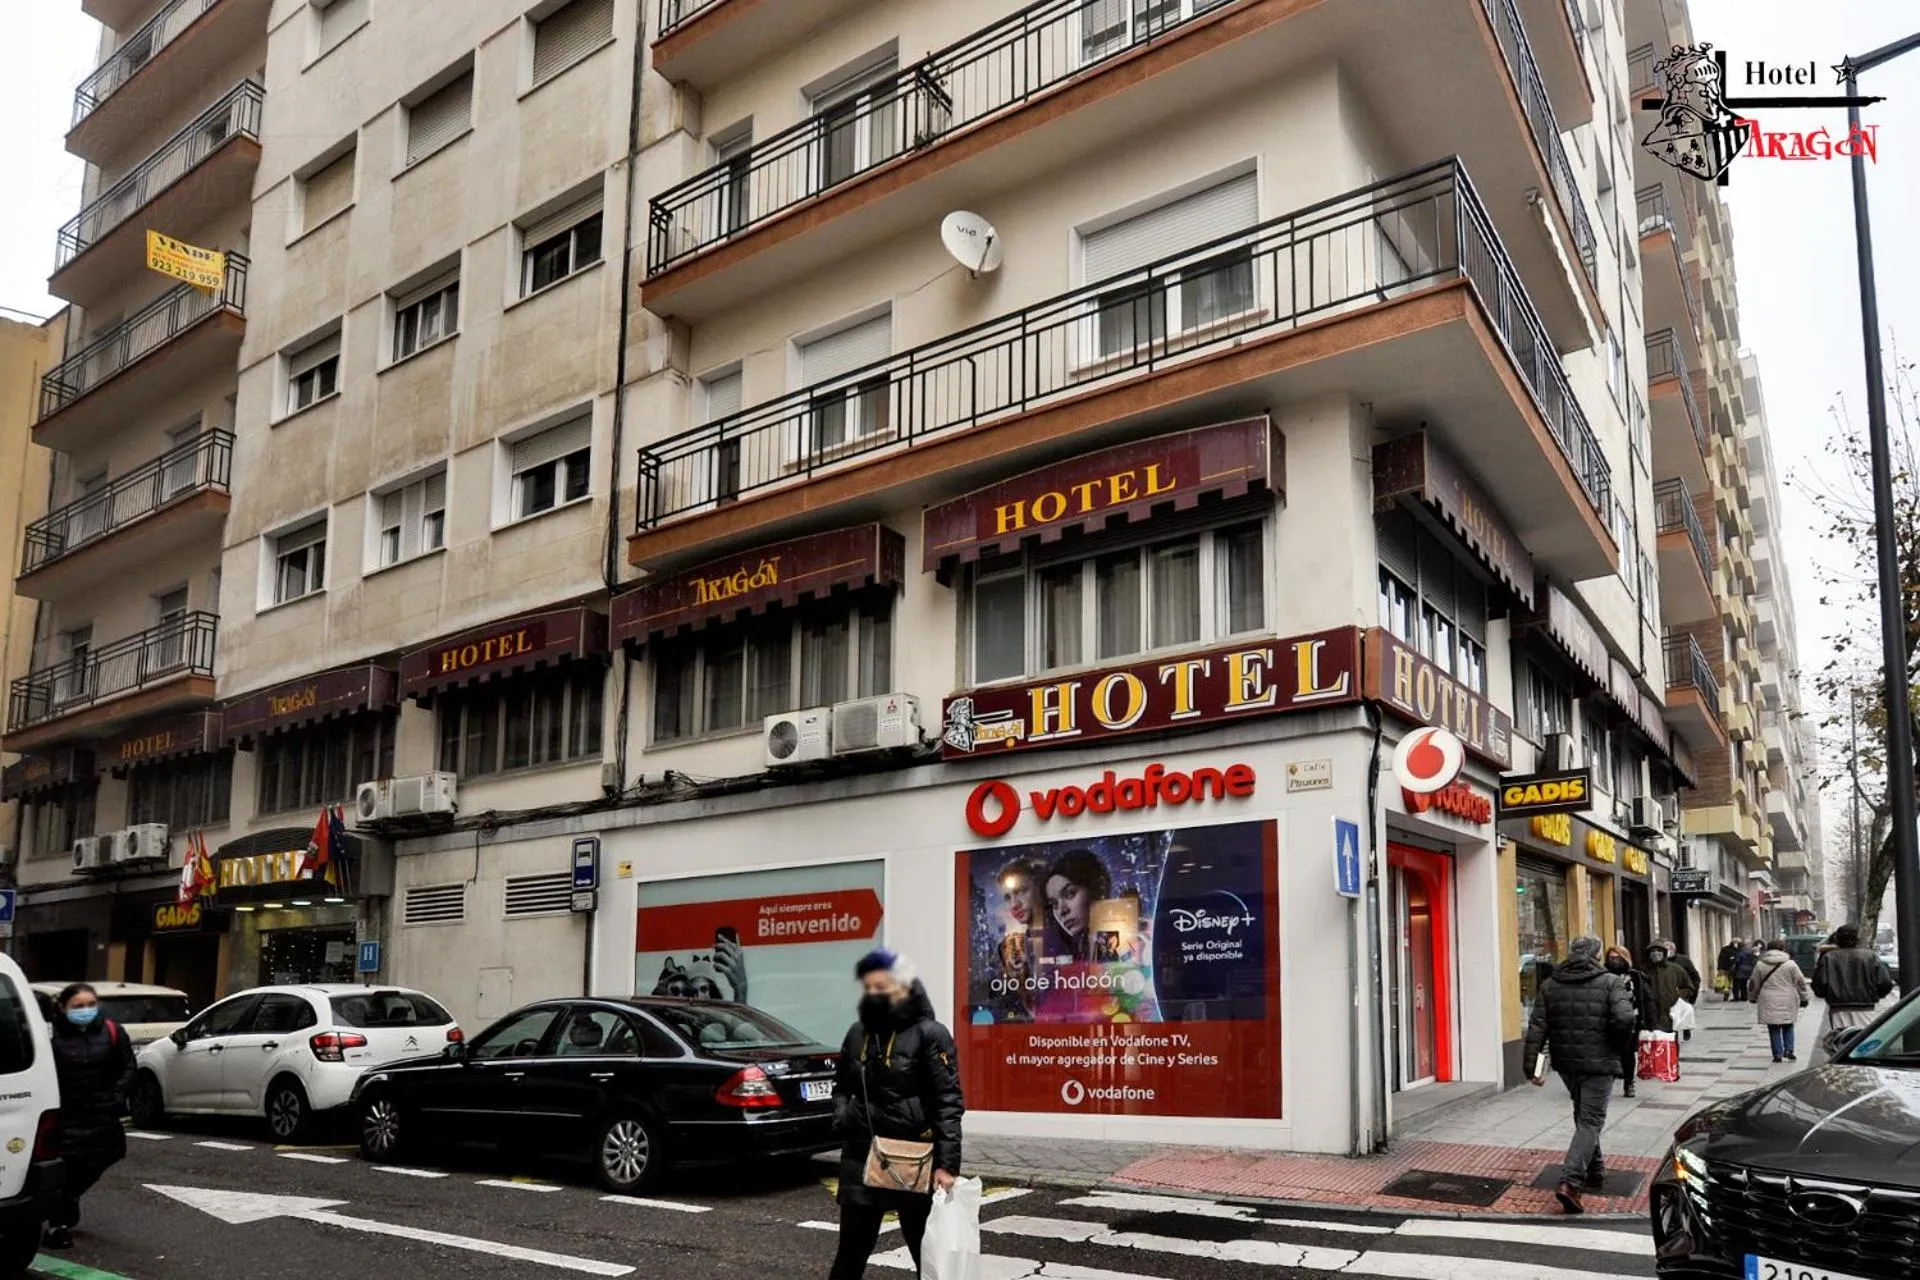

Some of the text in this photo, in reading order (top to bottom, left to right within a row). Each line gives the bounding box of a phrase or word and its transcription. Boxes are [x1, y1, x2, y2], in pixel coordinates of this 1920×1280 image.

[151, 257, 172, 273] 923
[175, 265, 196, 280] 219
[994, 462, 1177, 534] HOTEL
[441, 629, 533, 673] HOTEL
[1026, 639, 1350, 743] HOTEL
[1392, 645, 1485, 751] HOTEL
[121, 731, 175, 760] HOTEL
[1029, 763, 1256, 821] vodafone
[1504, 779, 1585, 806] GADIS
[155, 902, 200, 929] GADIS
[779, 902, 812, 914] siempre
[813, 901, 832, 911] eres
[757, 912, 862, 937] Bienvenido
[1181, 940, 1243, 952] Serie Original
[1183, 950, 1244, 964] ya disponible
[990, 969, 1126, 996] ojo de halcón
[1028, 1034, 1191, 1049] Disponible en Vodafone TV,
[1005, 1053, 1219, 1068] el mayor agregador de Cine y Series
[1087, 1085, 1156, 1099] vodafone
